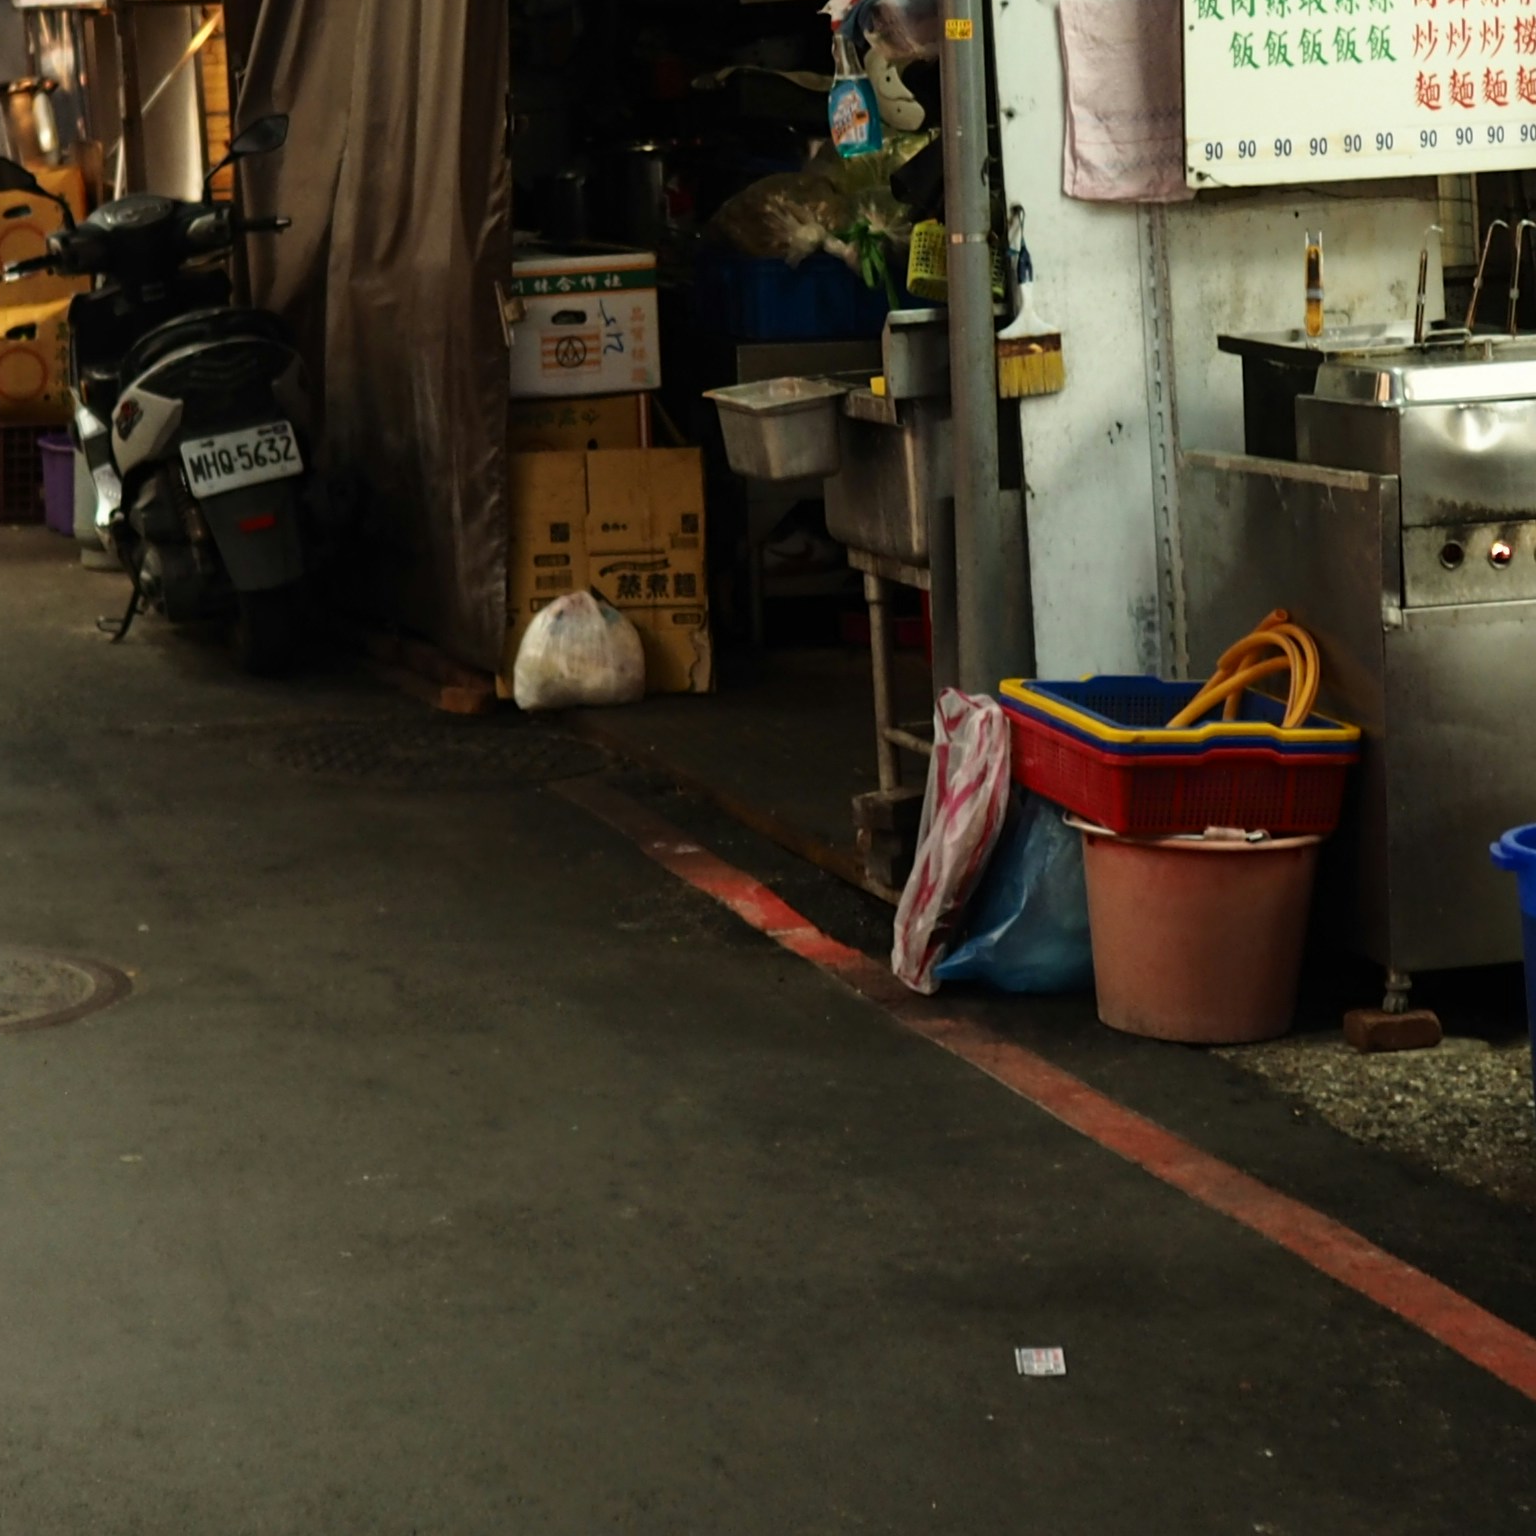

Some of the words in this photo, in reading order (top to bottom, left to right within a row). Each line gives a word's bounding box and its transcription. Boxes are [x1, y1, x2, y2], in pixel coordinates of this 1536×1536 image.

[1205, 142, 1223, 161] 90
[1238, 140, 1257, 159] 90
[1274, 138, 1292, 157] 90
[1309, 137, 1328, 156] 90
[1344, 134, 1362, 153] 90
[1375, 132, 1394, 151] 90
[1420, 130, 1437, 147] 90
[1455, 127, 1473, 145] 90
[1487, 126, 1505, 143] 90
